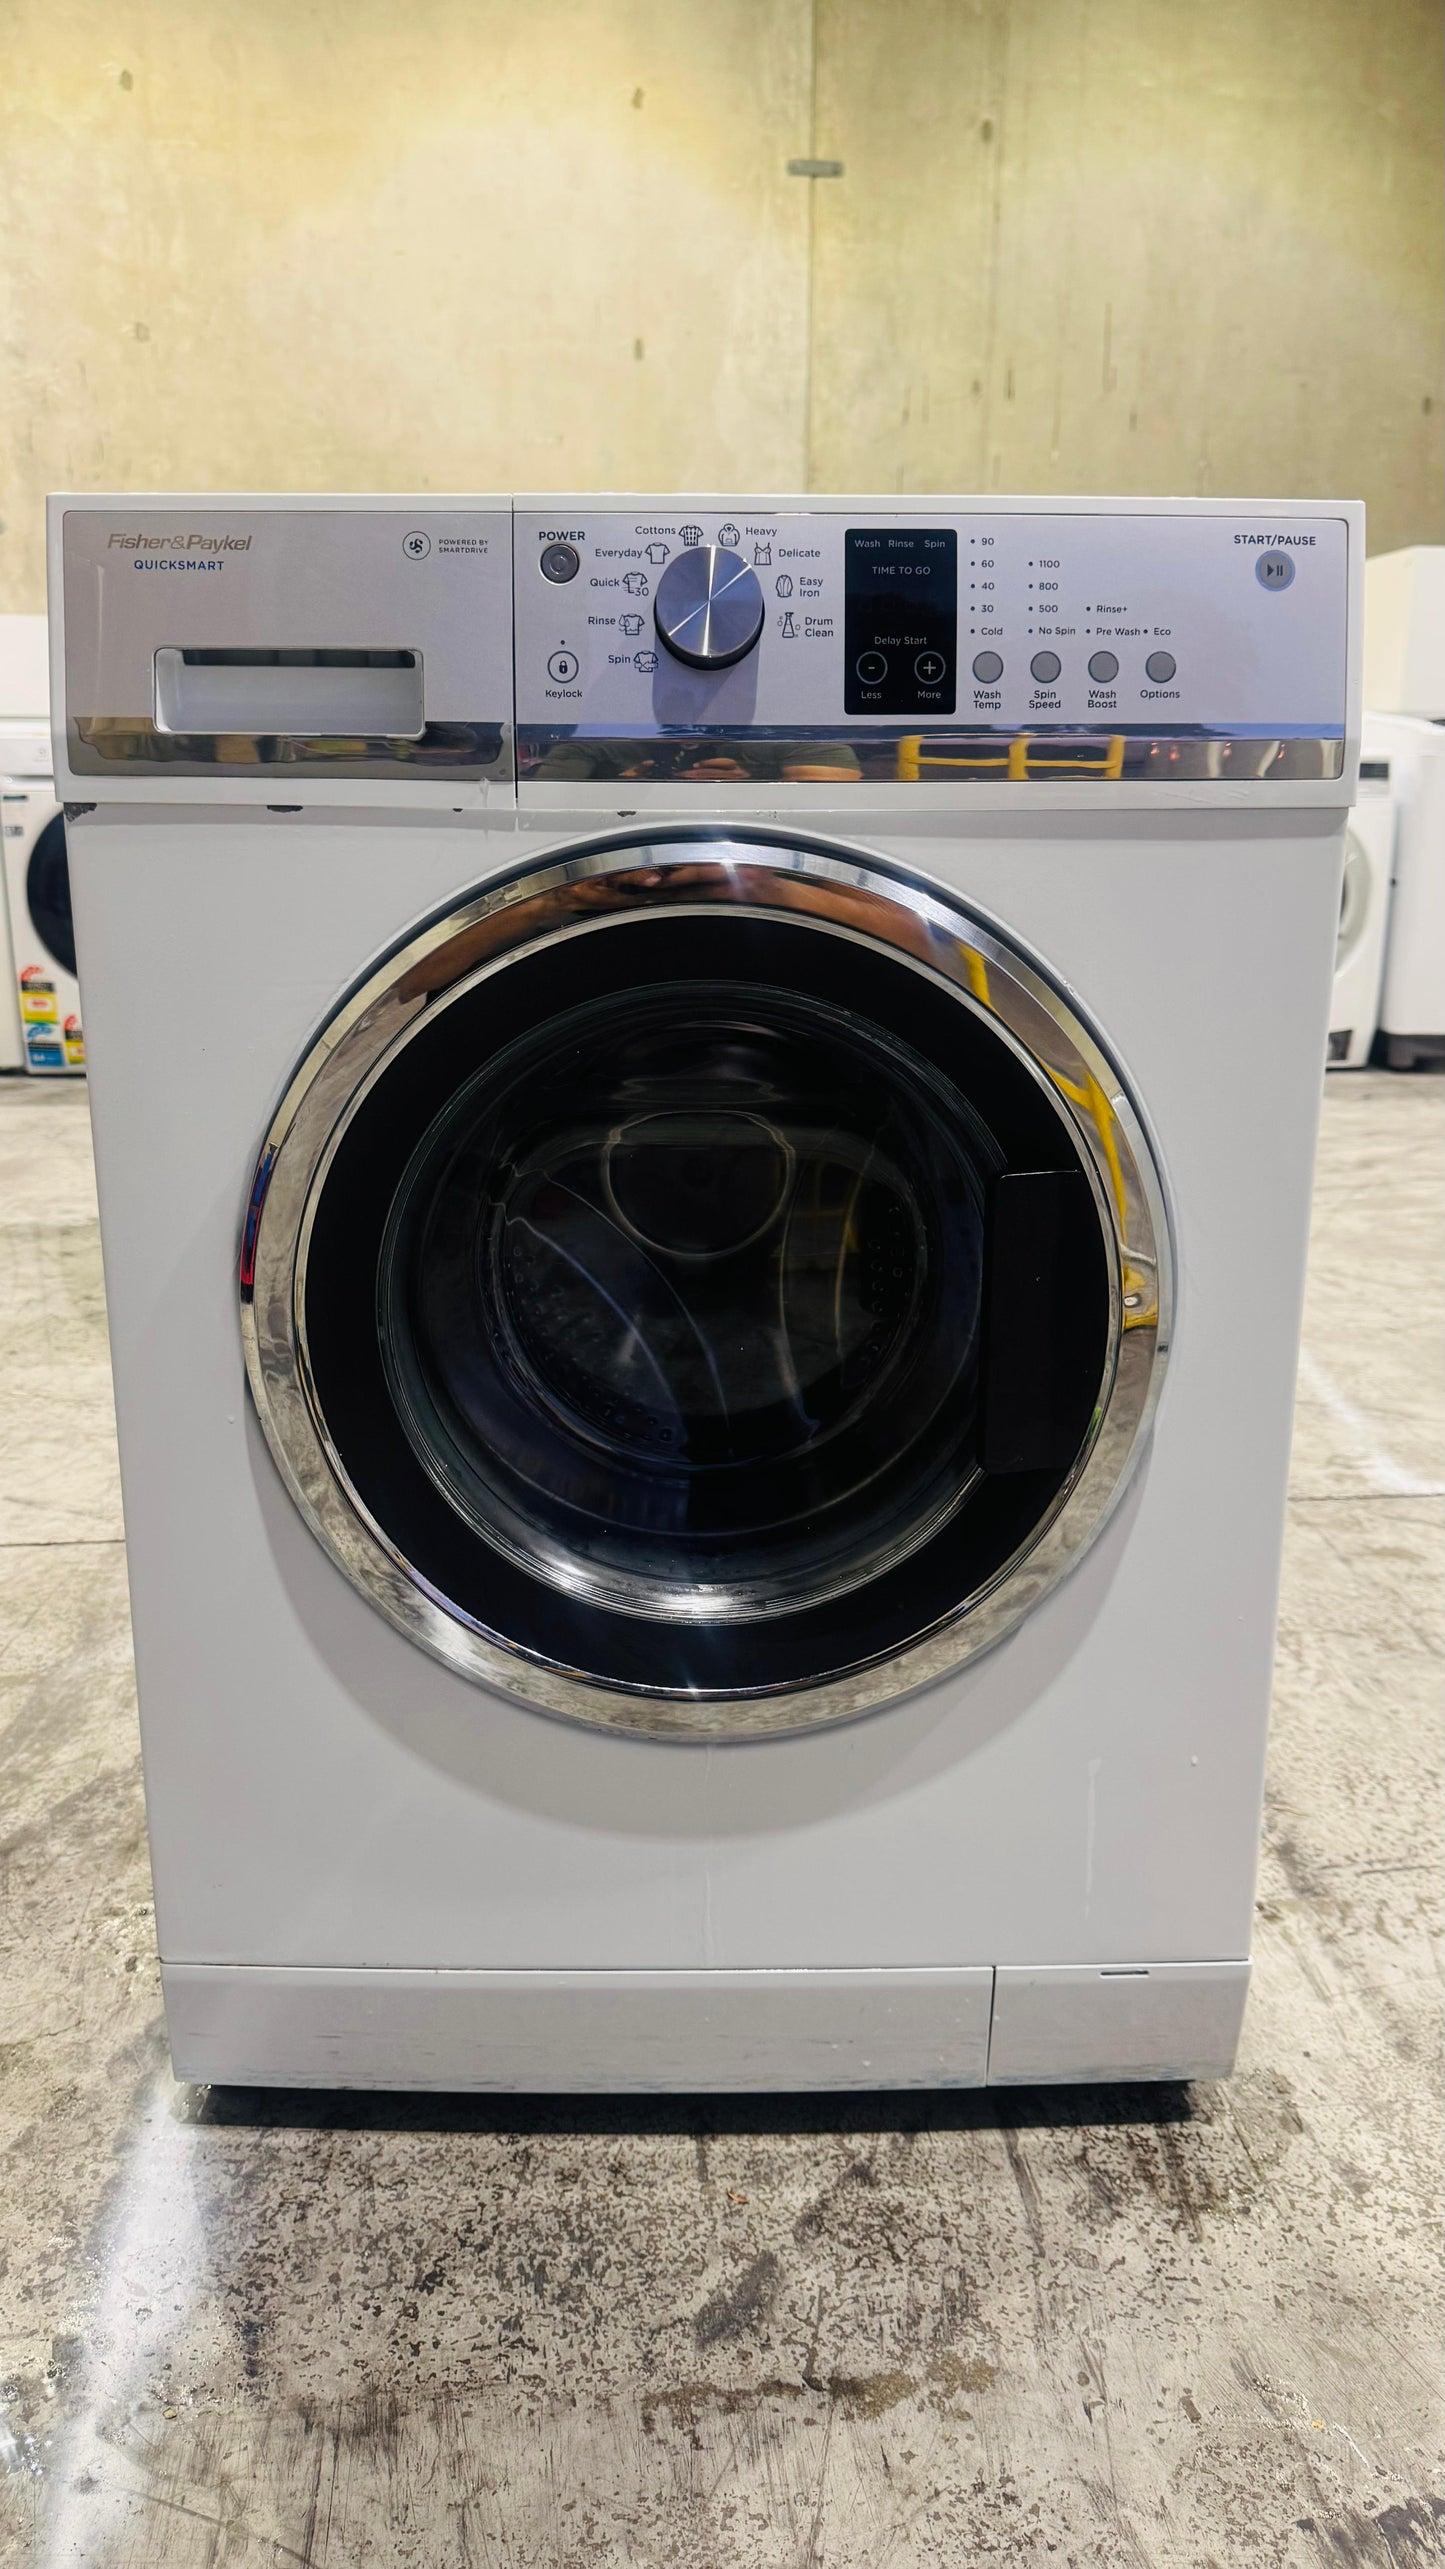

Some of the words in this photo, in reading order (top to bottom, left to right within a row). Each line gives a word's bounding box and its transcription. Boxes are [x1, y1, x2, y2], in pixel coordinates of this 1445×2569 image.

[634, 525, 676, 535] Cottons
[745, 526, 778, 538] Heavy
[538, 530, 586, 541] POWER
[1233, 534, 1317, 547] START/PAUSE
[107, 533, 253, 554] Fisher&Paykel
[438, 538, 475, 546] POWERED
[477, 538, 490, 546] BY
[854, 539, 881, 548] Wash
[888, 539, 915, 548] Rinse
[924, 539, 946, 548] Spin
[981, 537, 995, 546] 90
[438, 546, 489, 554] SMARTDRIVE
[595, 548, 643, 559] Everyday
[778, 548, 821, 558] Delicate
[133, 559, 225, 571] QUICKSMART
[981, 559, 995, 569] 60
[1039, 559, 1061, 569] 1100
[871, 566, 896, 575] TIME
[898, 566, 912, 575] TO
[914, 566, 931, 575] GO
[589, 577, 620, 587] Quick
[799, 576, 824, 588] Easy
[981, 581, 995, 591] 40
[1038, 582, 1059, 591] 800
[634, 587, 650, 597] 30
[799, 588, 820, 598] Iron
[981, 604, 994, 613] 30
[1038, 604, 1059, 613] 500
[1096, 604, 1128, 614] Rinse+
[587, 615, 616, 626] Rinse
[804, 616, 834, 626] Drum
[804, 628, 834, 638] Clean
[980, 626, 1004, 636] Cold
[1038, 626, 1053, 635] No
[1054, 626, 1076, 637] Spin
[1096, 627, 1112, 636] Pre
[1114, 627, 1141, 636] Wash
[1153, 627, 1172, 636] Eco
[874, 636, 902, 647] Delay
[903, 636, 927, 645] Start
[607, 654, 631, 665] Spin
[545, 689, 583, 700] Keylock
[860, 691, 882, 700] Less
[917, 690, 942, 699] More
[973, 690, 1002, 700] Wash
[1033, 689, 1057, 699] Spin
[1088, 689, 1117, 699] Wash
[1139, 689, 1181, 699] Options
[972, 700, 1002, 710] Temp
[1028, 699, 1062, 710] Speed
[1087, 699, 1118, 709] Boost
